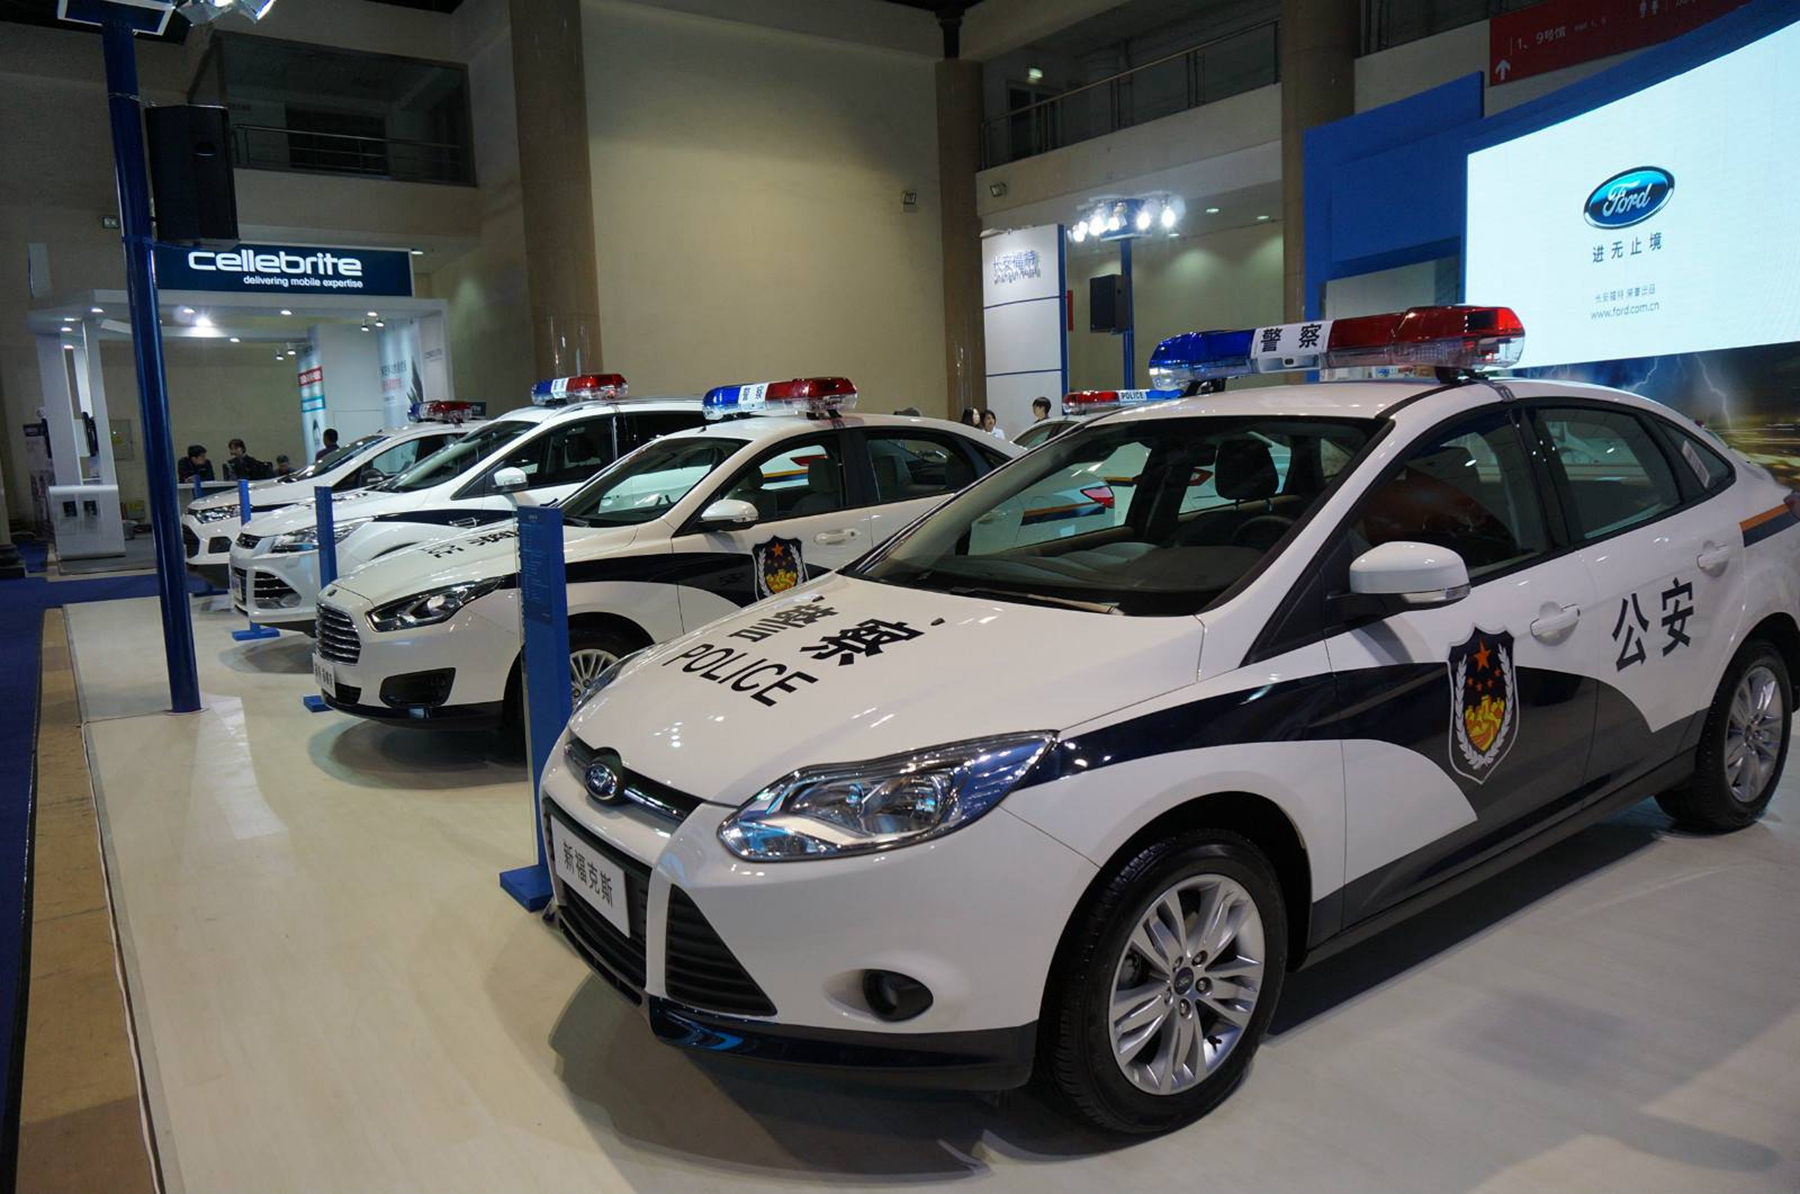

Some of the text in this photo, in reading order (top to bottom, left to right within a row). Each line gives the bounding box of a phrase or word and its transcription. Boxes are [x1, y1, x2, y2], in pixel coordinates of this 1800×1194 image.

[1602, 180, 1653, 217] Ford
[188, 249, 363, 276] cellebrite
[1592, 232, 1662, 263] 进无止境
[243, 275, 363, 289] delivering mobile expertise
[1591, 301, 1660, 320] www.ford.com.cn
[1260, 323, 1322, 352] 警察
[1120, 391, 1145, 401] POLICE
[728, 603, 925, 666] 警察
[1611, 577, 1694, 672] 公安
[662, 643, 819, 707] POLICE
[562, 839, 613, 908] 新福克斯
